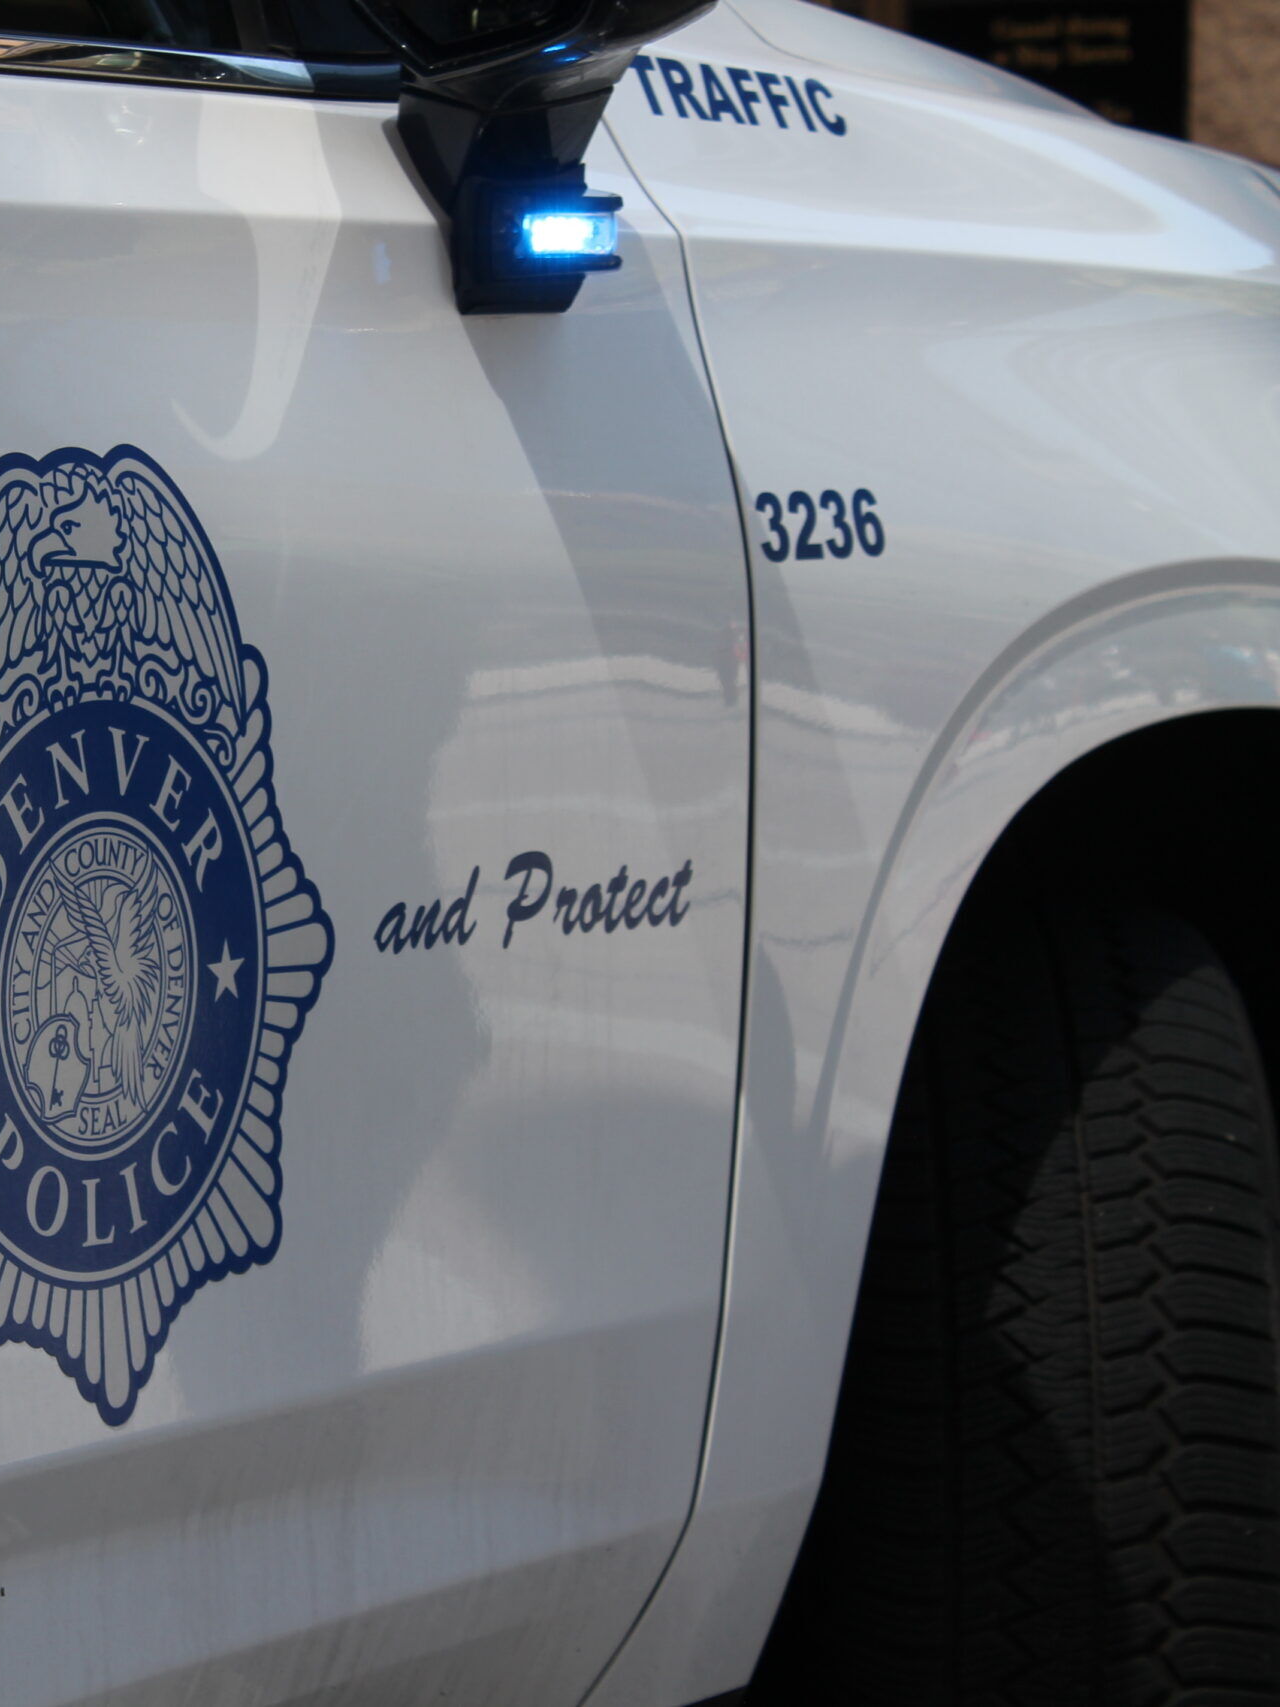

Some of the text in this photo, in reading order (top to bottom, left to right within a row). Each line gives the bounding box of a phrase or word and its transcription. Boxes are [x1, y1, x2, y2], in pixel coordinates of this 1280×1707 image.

[628, 55, 848, 136] TRAFFIC
[755, 488, 886, 563] 3236
[373, 851, 693, 955] and Protect
[13, 837, 184, 1082] CITY AND COUNTY OF DENVER
[78, 1106, 127, 1136] SEAL
